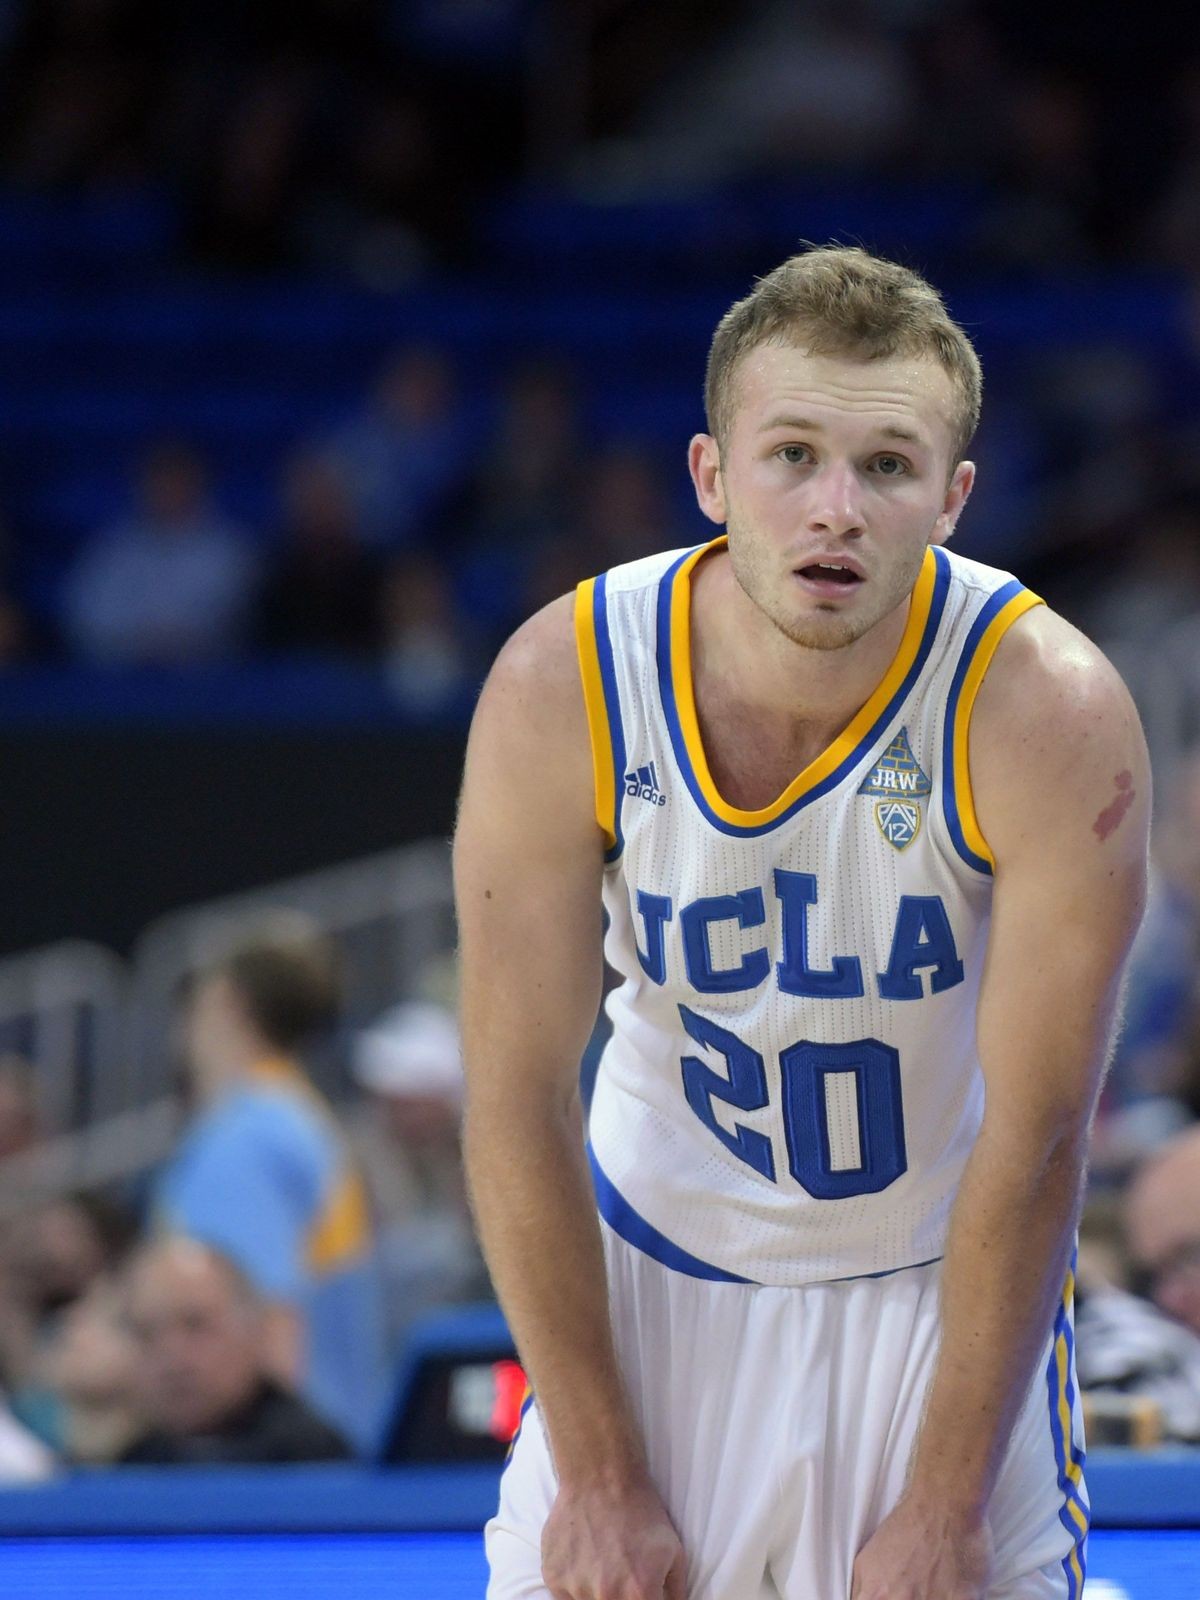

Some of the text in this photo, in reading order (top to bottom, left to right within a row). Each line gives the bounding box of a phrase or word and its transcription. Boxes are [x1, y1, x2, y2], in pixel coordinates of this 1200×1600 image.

[872, 768, 920, 791] JRW
[625, 781, 667, 807] didas
[888, 822, 911, 842] 12
[677, 1002, 909, 1201] 20
